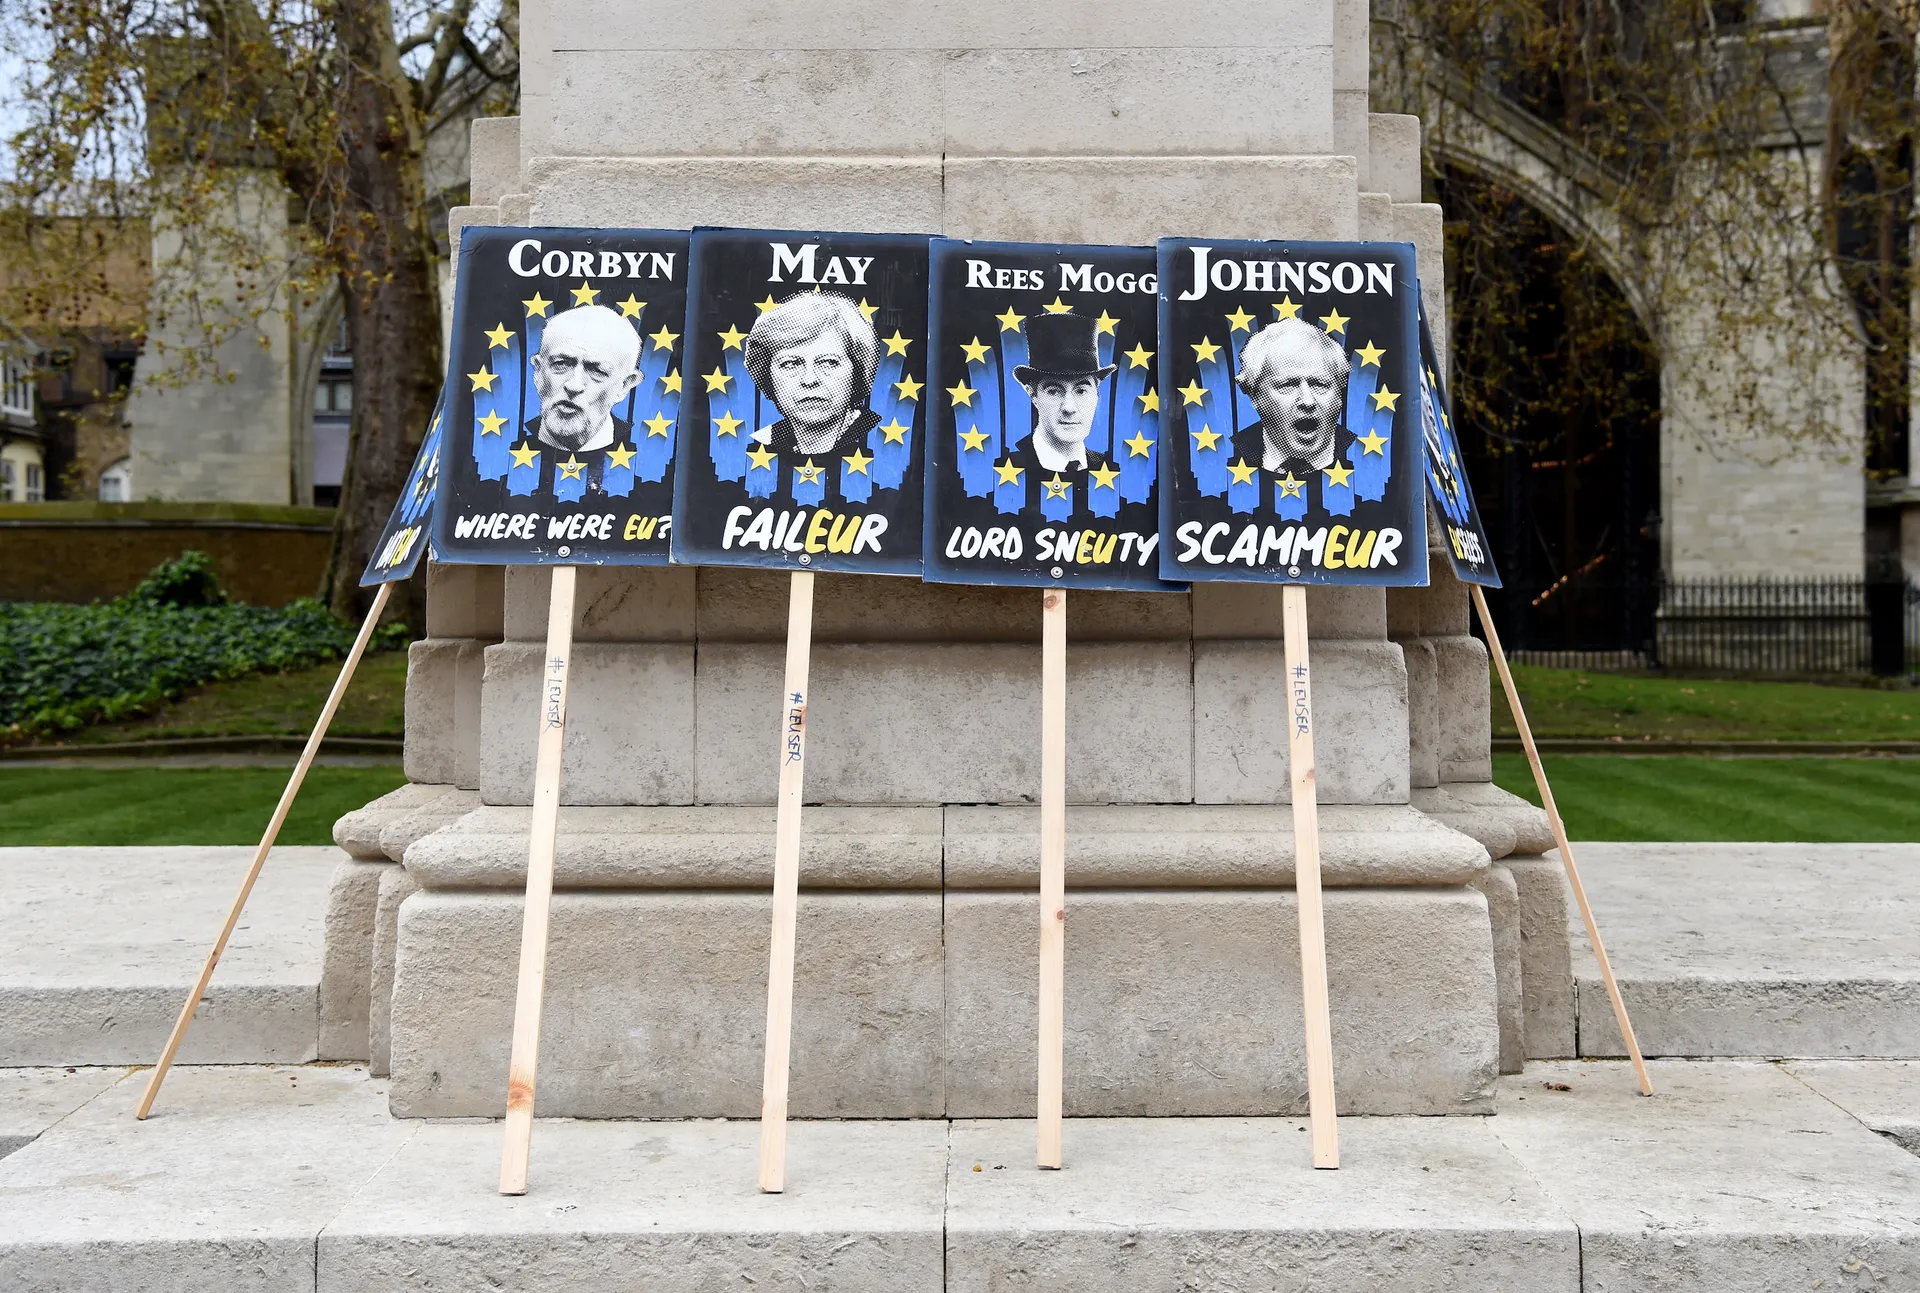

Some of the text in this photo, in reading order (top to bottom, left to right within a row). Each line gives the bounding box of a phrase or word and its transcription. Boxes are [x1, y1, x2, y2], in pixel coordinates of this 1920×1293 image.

[508, 239, 676, 282] CORBYN
[768, 242, 875, 285] MAY
[965, 259, 1045, 292] REES
[1177, 246, 1396, 301] JOHNSON
[454, 512, 673, 541] WHERE WERE EU?
[722, 505, 889, 553] FAILEUR
[945, 525, 1160, 567] LORD SNEUTY
[1176, 520, 1403, 570] SCAMMEUR
